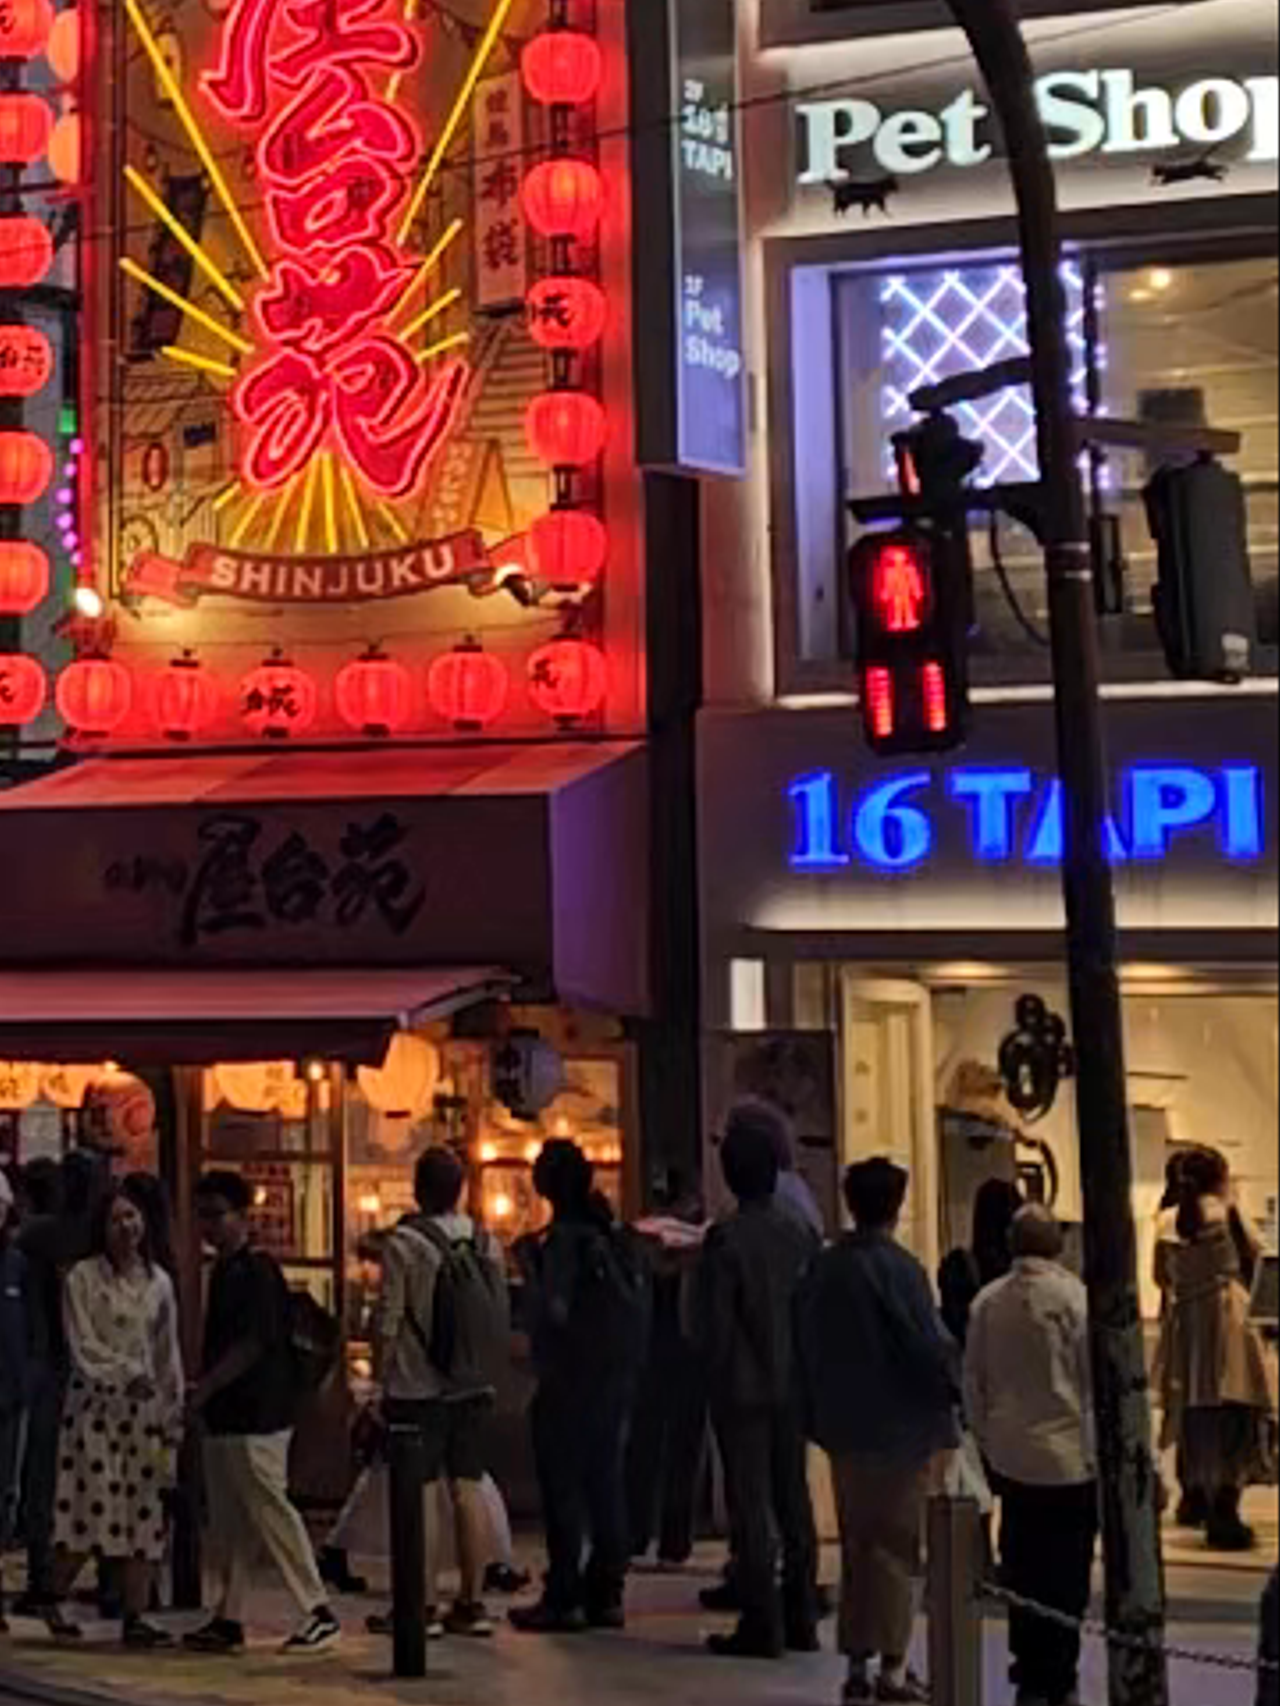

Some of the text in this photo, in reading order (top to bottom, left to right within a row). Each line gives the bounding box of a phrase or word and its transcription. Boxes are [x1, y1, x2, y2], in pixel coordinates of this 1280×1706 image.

[796, 94, 992, 187] Pet
[686, 299, 723, 336] Pet
[685, 334, 740, 379] Shop
[209, 543, 455, 596] SHINJUKU
[786, 769, 935, 872] 16
[180, 812, 429, 948] 屋台苑
